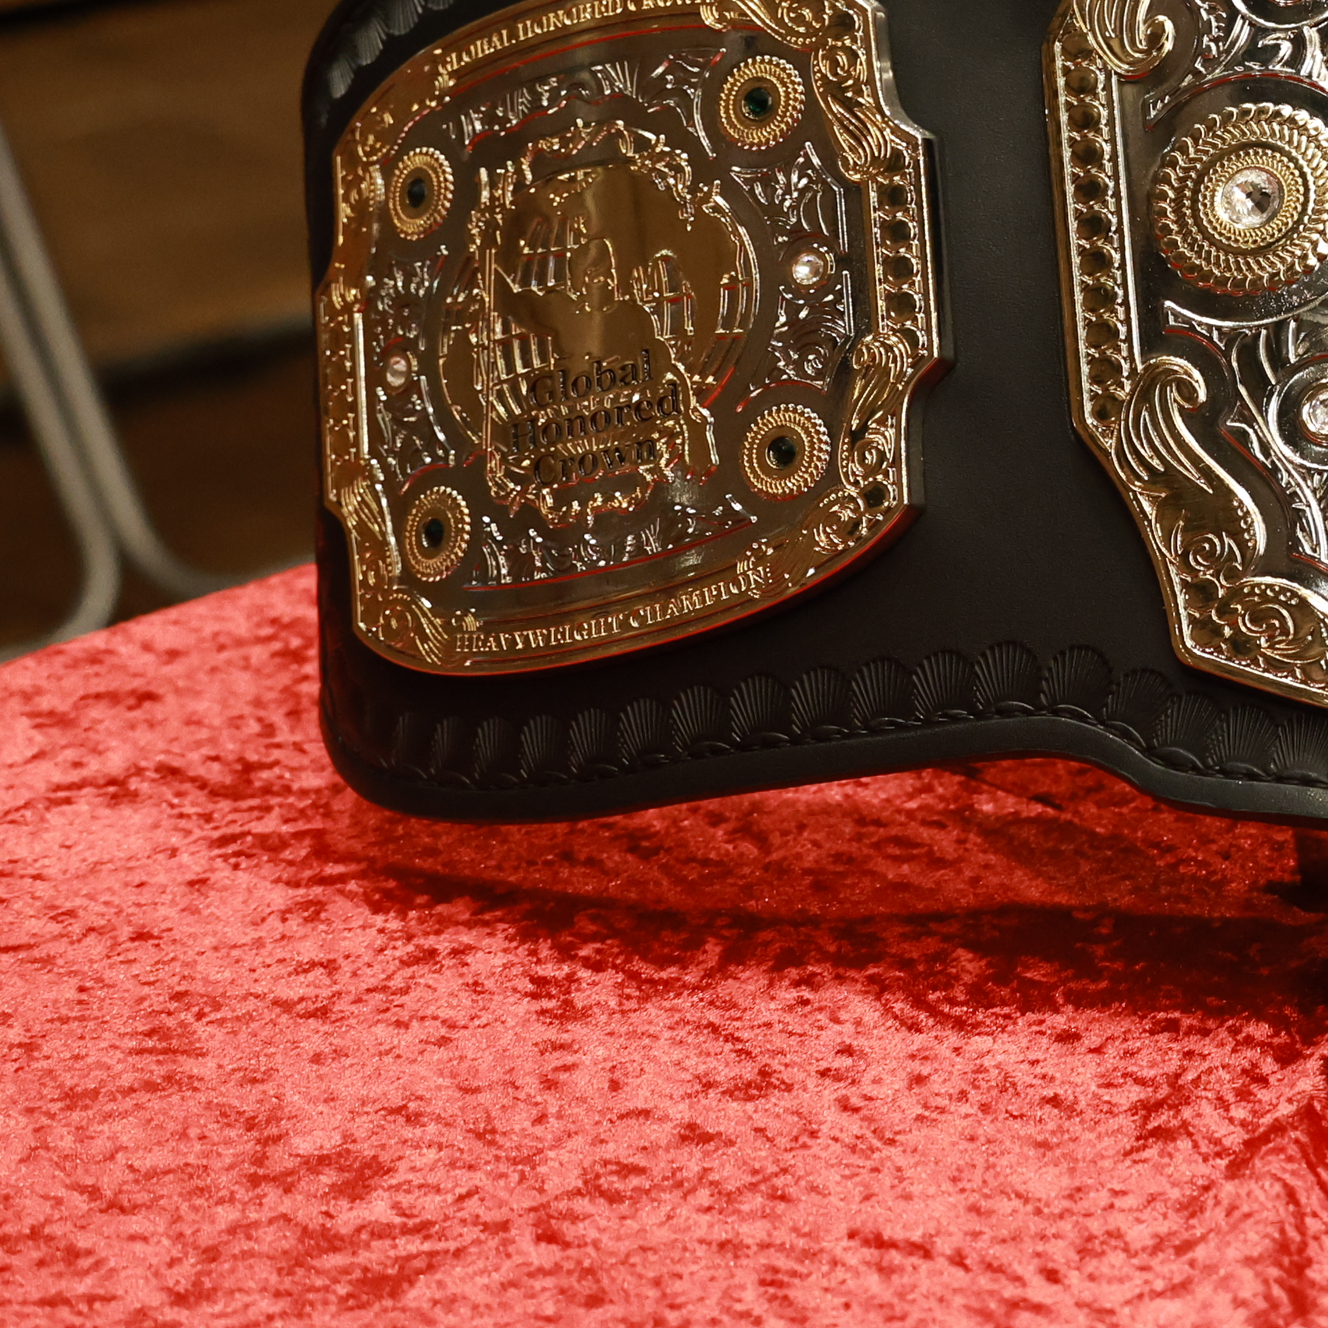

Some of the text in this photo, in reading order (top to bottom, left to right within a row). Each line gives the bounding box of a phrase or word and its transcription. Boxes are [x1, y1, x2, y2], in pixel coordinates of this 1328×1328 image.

[528, 348, 654, 408] Global
[509, 381, 683, 453] Honored
[533, 437, 657, 486] Crown
